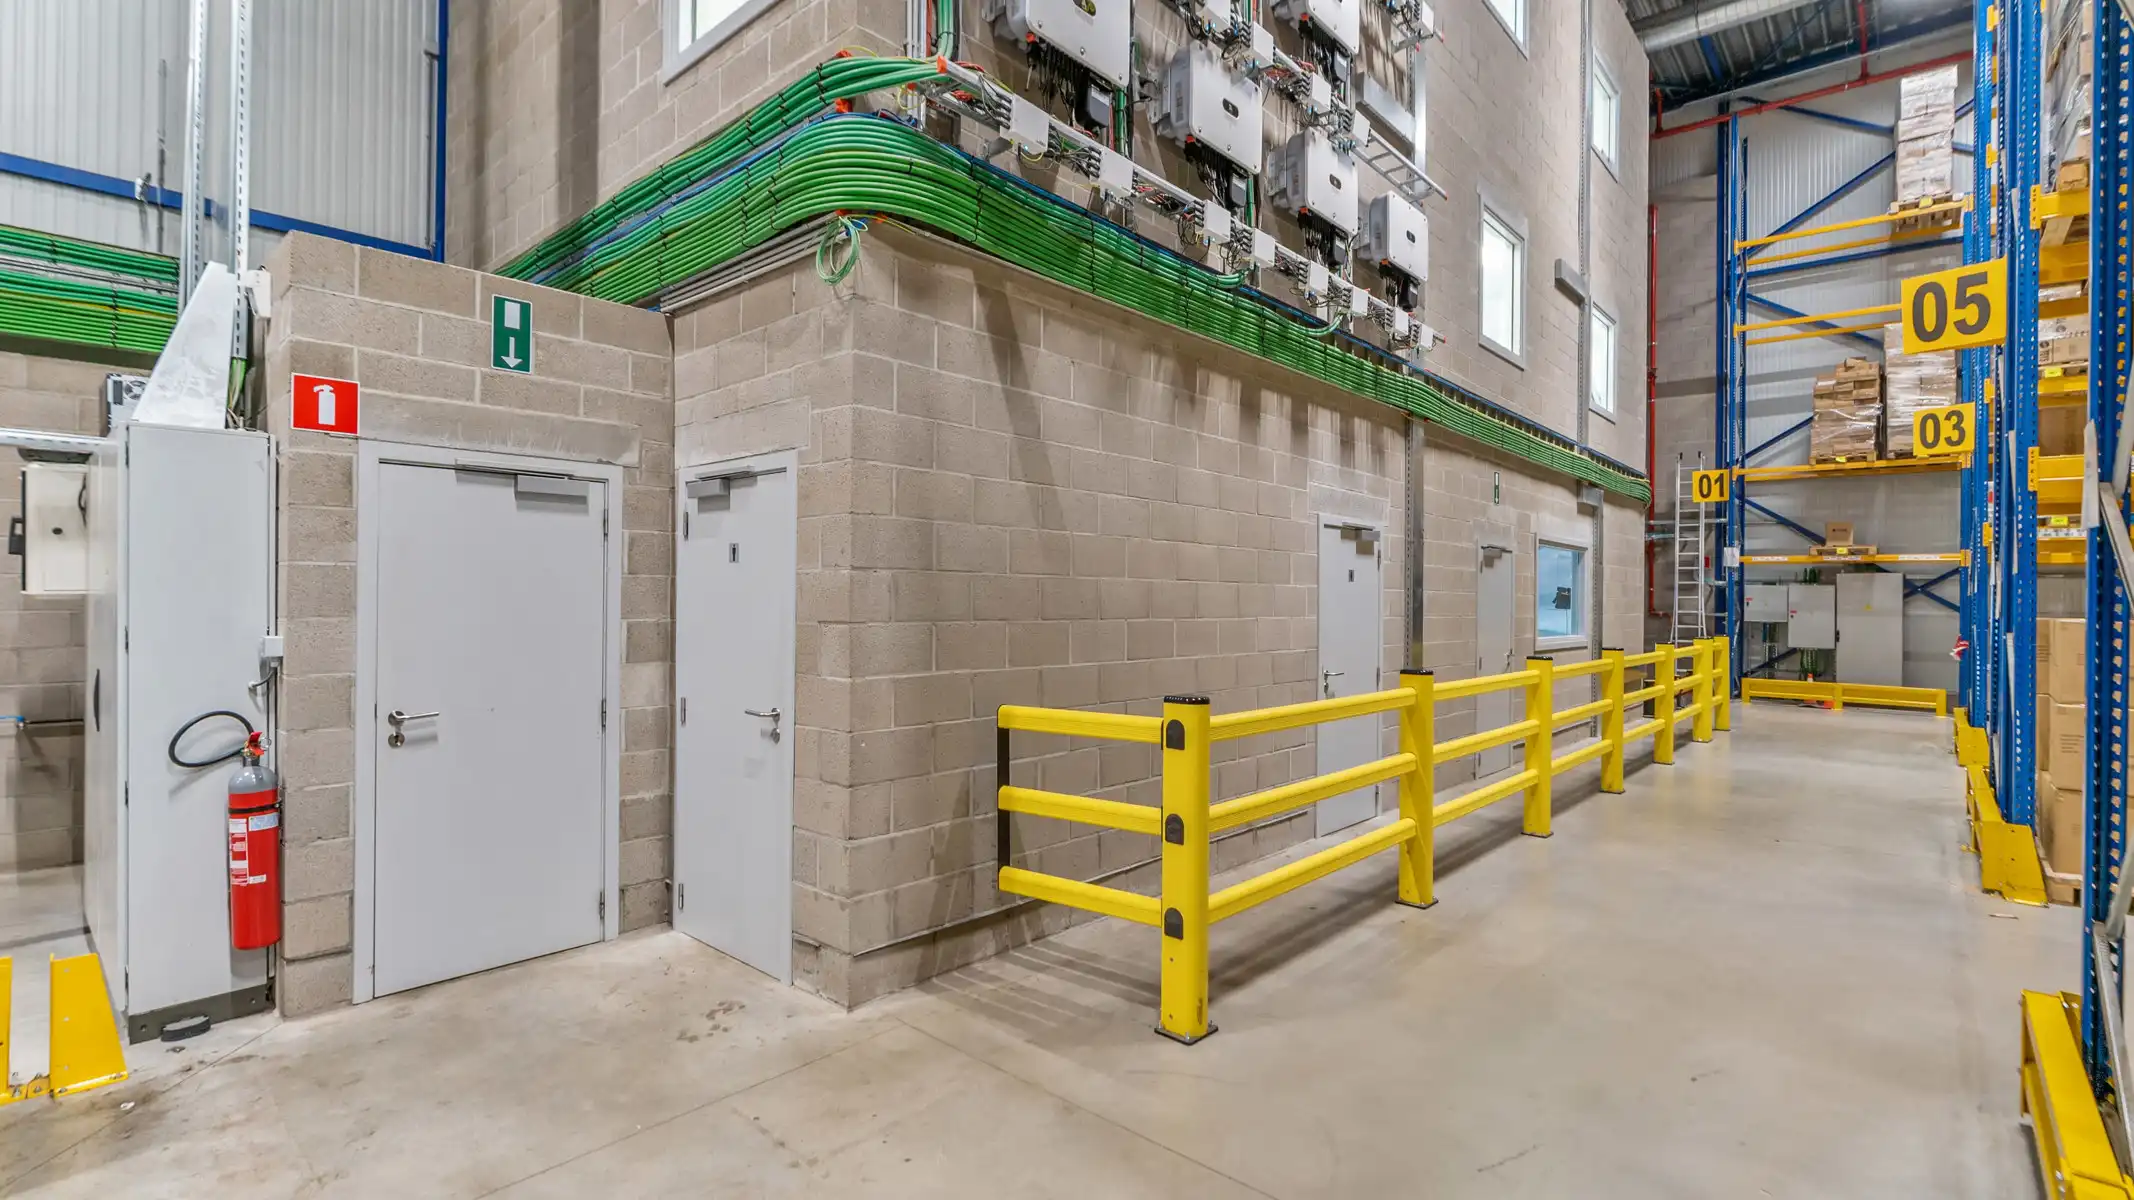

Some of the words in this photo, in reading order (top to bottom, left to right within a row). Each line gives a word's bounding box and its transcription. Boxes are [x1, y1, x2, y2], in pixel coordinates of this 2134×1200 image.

[1912, 271, 1991, 342] 05
[1919, 410, 1966, 449] 03
[1698, 473, 1726, 499] 01
